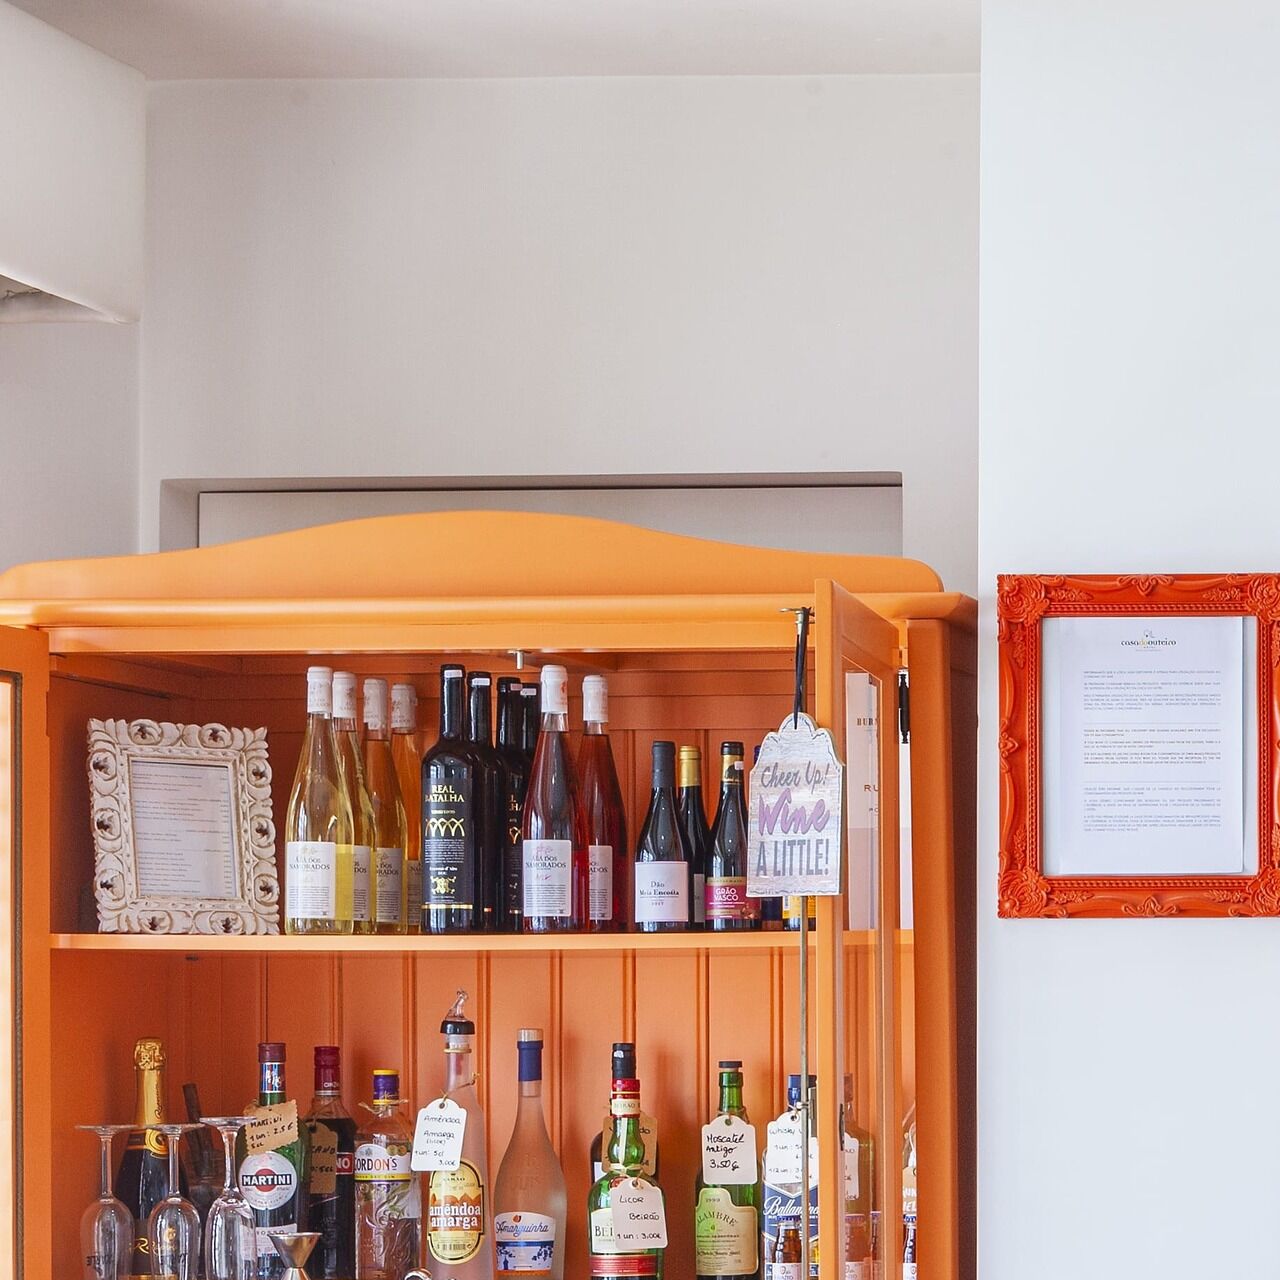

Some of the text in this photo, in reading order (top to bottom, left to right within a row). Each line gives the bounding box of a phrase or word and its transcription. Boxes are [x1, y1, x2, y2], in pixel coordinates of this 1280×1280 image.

[761, 760, 830, 795] Cheer Up!
[431, 784, 455, 794] REAL
[758, 787, 831, 837] Wine
[756, 838, 830, 877] A LITTLE!
[650, 880, 665, 888] Dão
[715, 886, 737, 895] GRÃO
[713, 893, 739, 902] VASCO
[242, 1174, 291, 1186] MARTINI
[429, 1202, 481, 1216] amêndoa
[431, 1216, 478, 1230] amarga
[495, 1220, 550, 1238] Amarguinha
